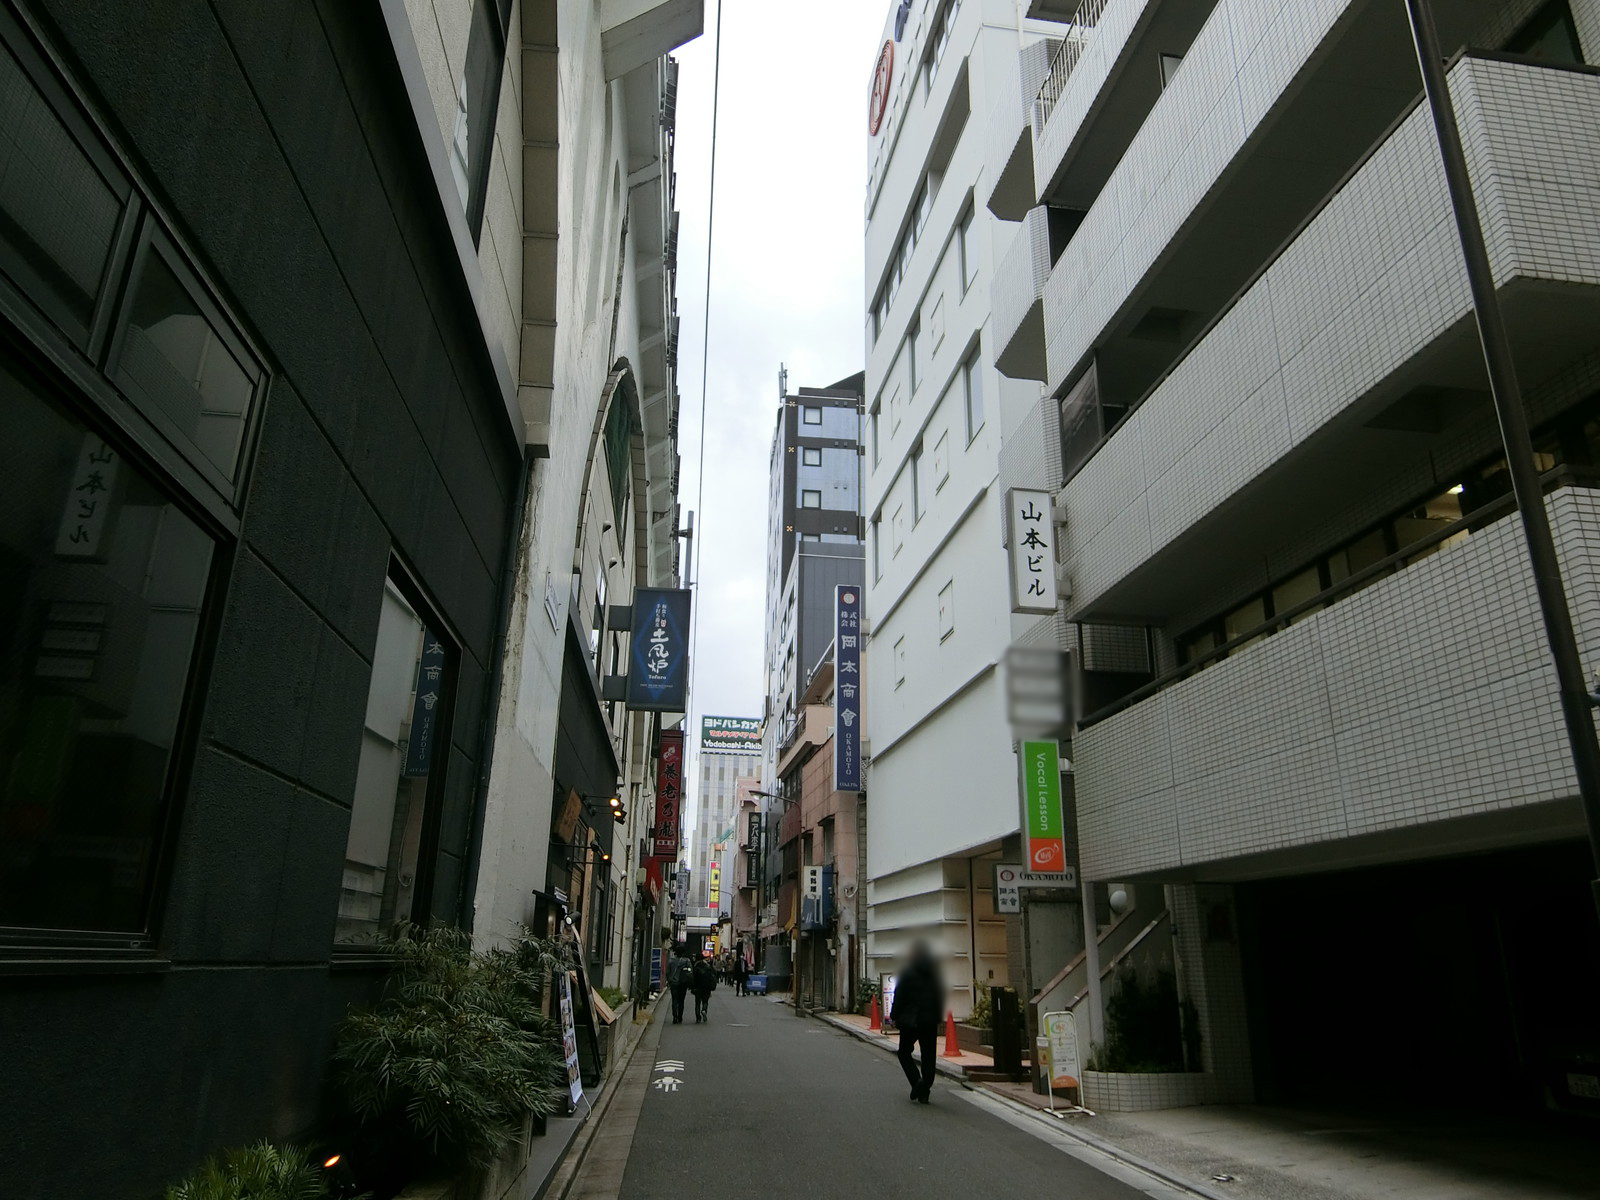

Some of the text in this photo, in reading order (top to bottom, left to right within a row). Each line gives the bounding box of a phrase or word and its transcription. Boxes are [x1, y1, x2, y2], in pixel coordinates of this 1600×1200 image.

[1021, 501, 1048, 596] 山本ビル
[704, 718, 762, 730] ヨドバシカメ
[1039, 791, 1049, 831] Lesson
[1019, 872, 1073, 881] OKAMOTO
